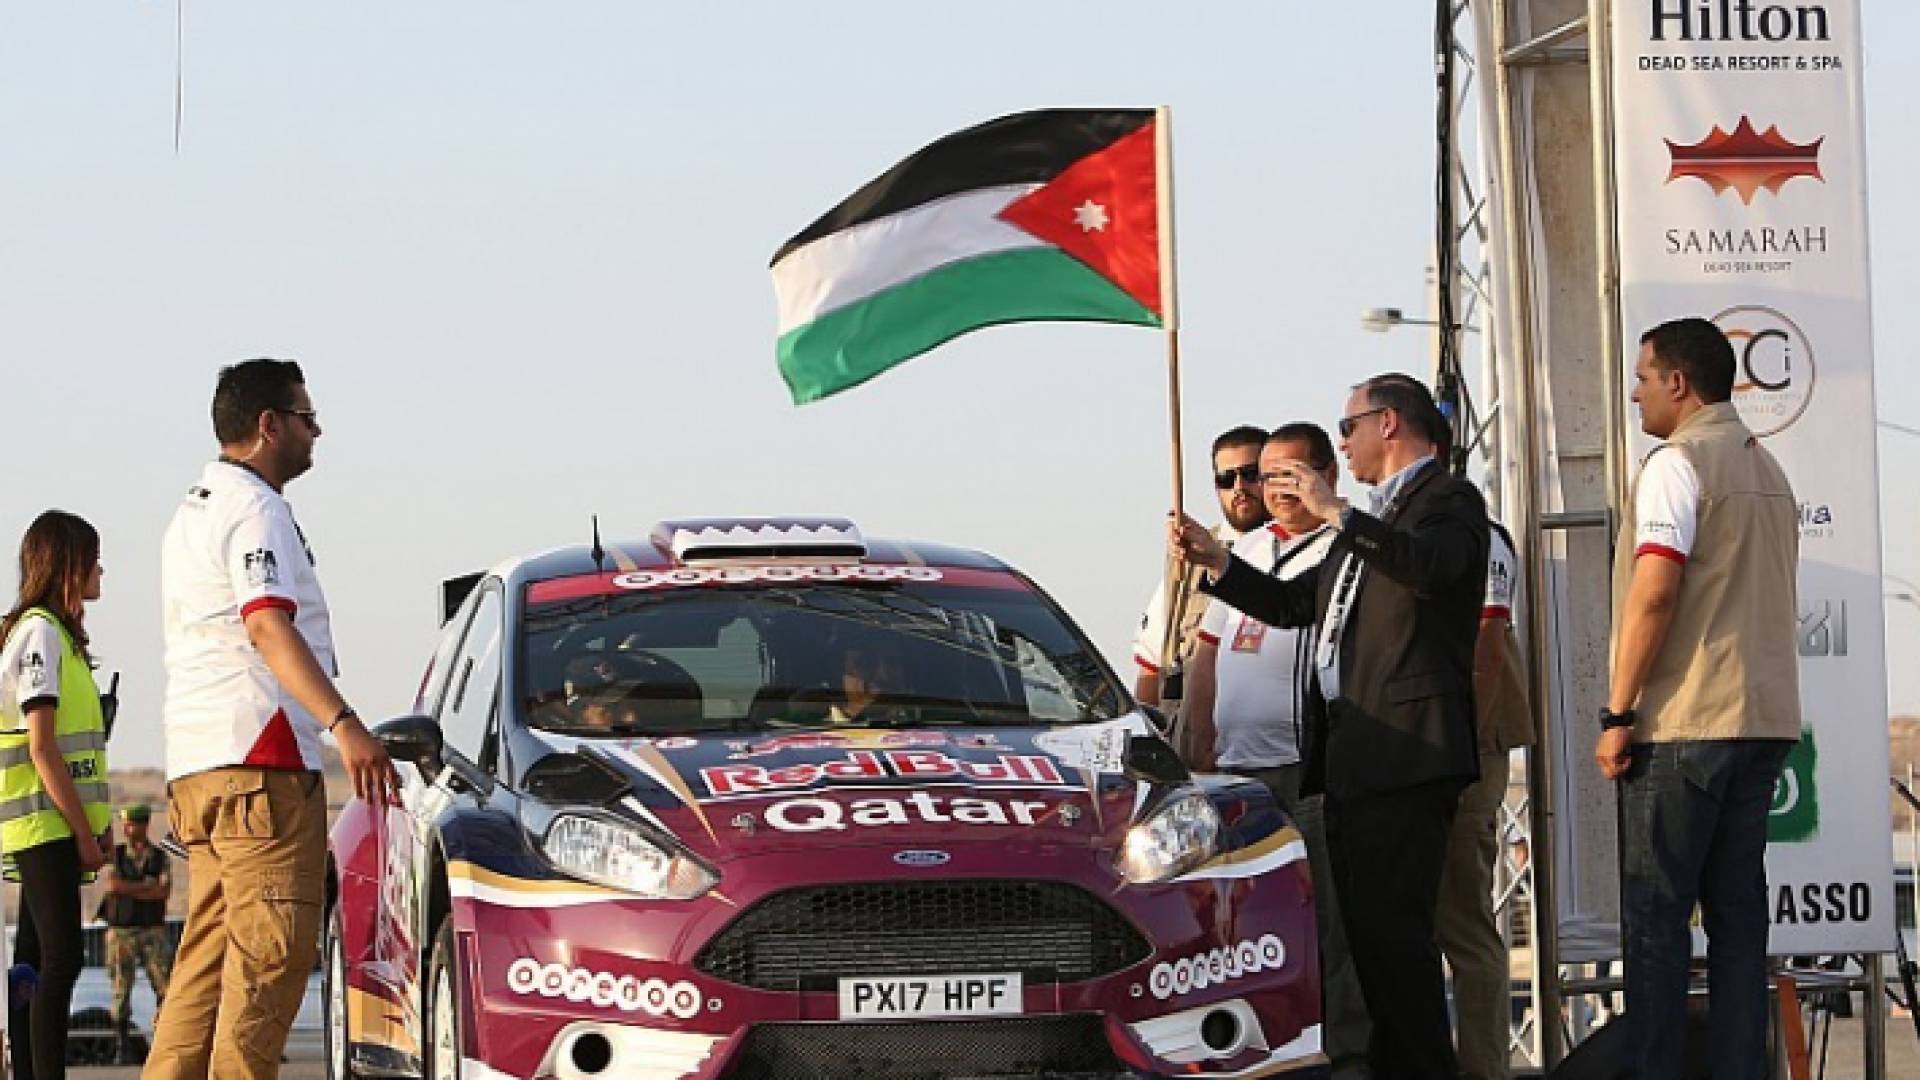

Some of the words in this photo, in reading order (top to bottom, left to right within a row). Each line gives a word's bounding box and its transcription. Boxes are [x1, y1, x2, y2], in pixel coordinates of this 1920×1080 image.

[1650, 0, 1831, 41] Hilton
[1638, 56, 1686, 71] DEAD
[1691, 56, 1723, 71] SEA
[1727, 56, 1791, 71] RESORT
[1796, 56, 1807, 71] &
[1811, 56, 1842, 71] SPA
[1665, 226, 1826, 254] SAMARAH
[699, 751, 886, 796] Red
[884, 750, 1064, 783] Bull
[764, 791, 1046, 831] Qatar
[1767, 882, 1871, 924] ASSO
[853, 982, 930, 1013] PX17
[944, 979, 1007, 1011] HPF
